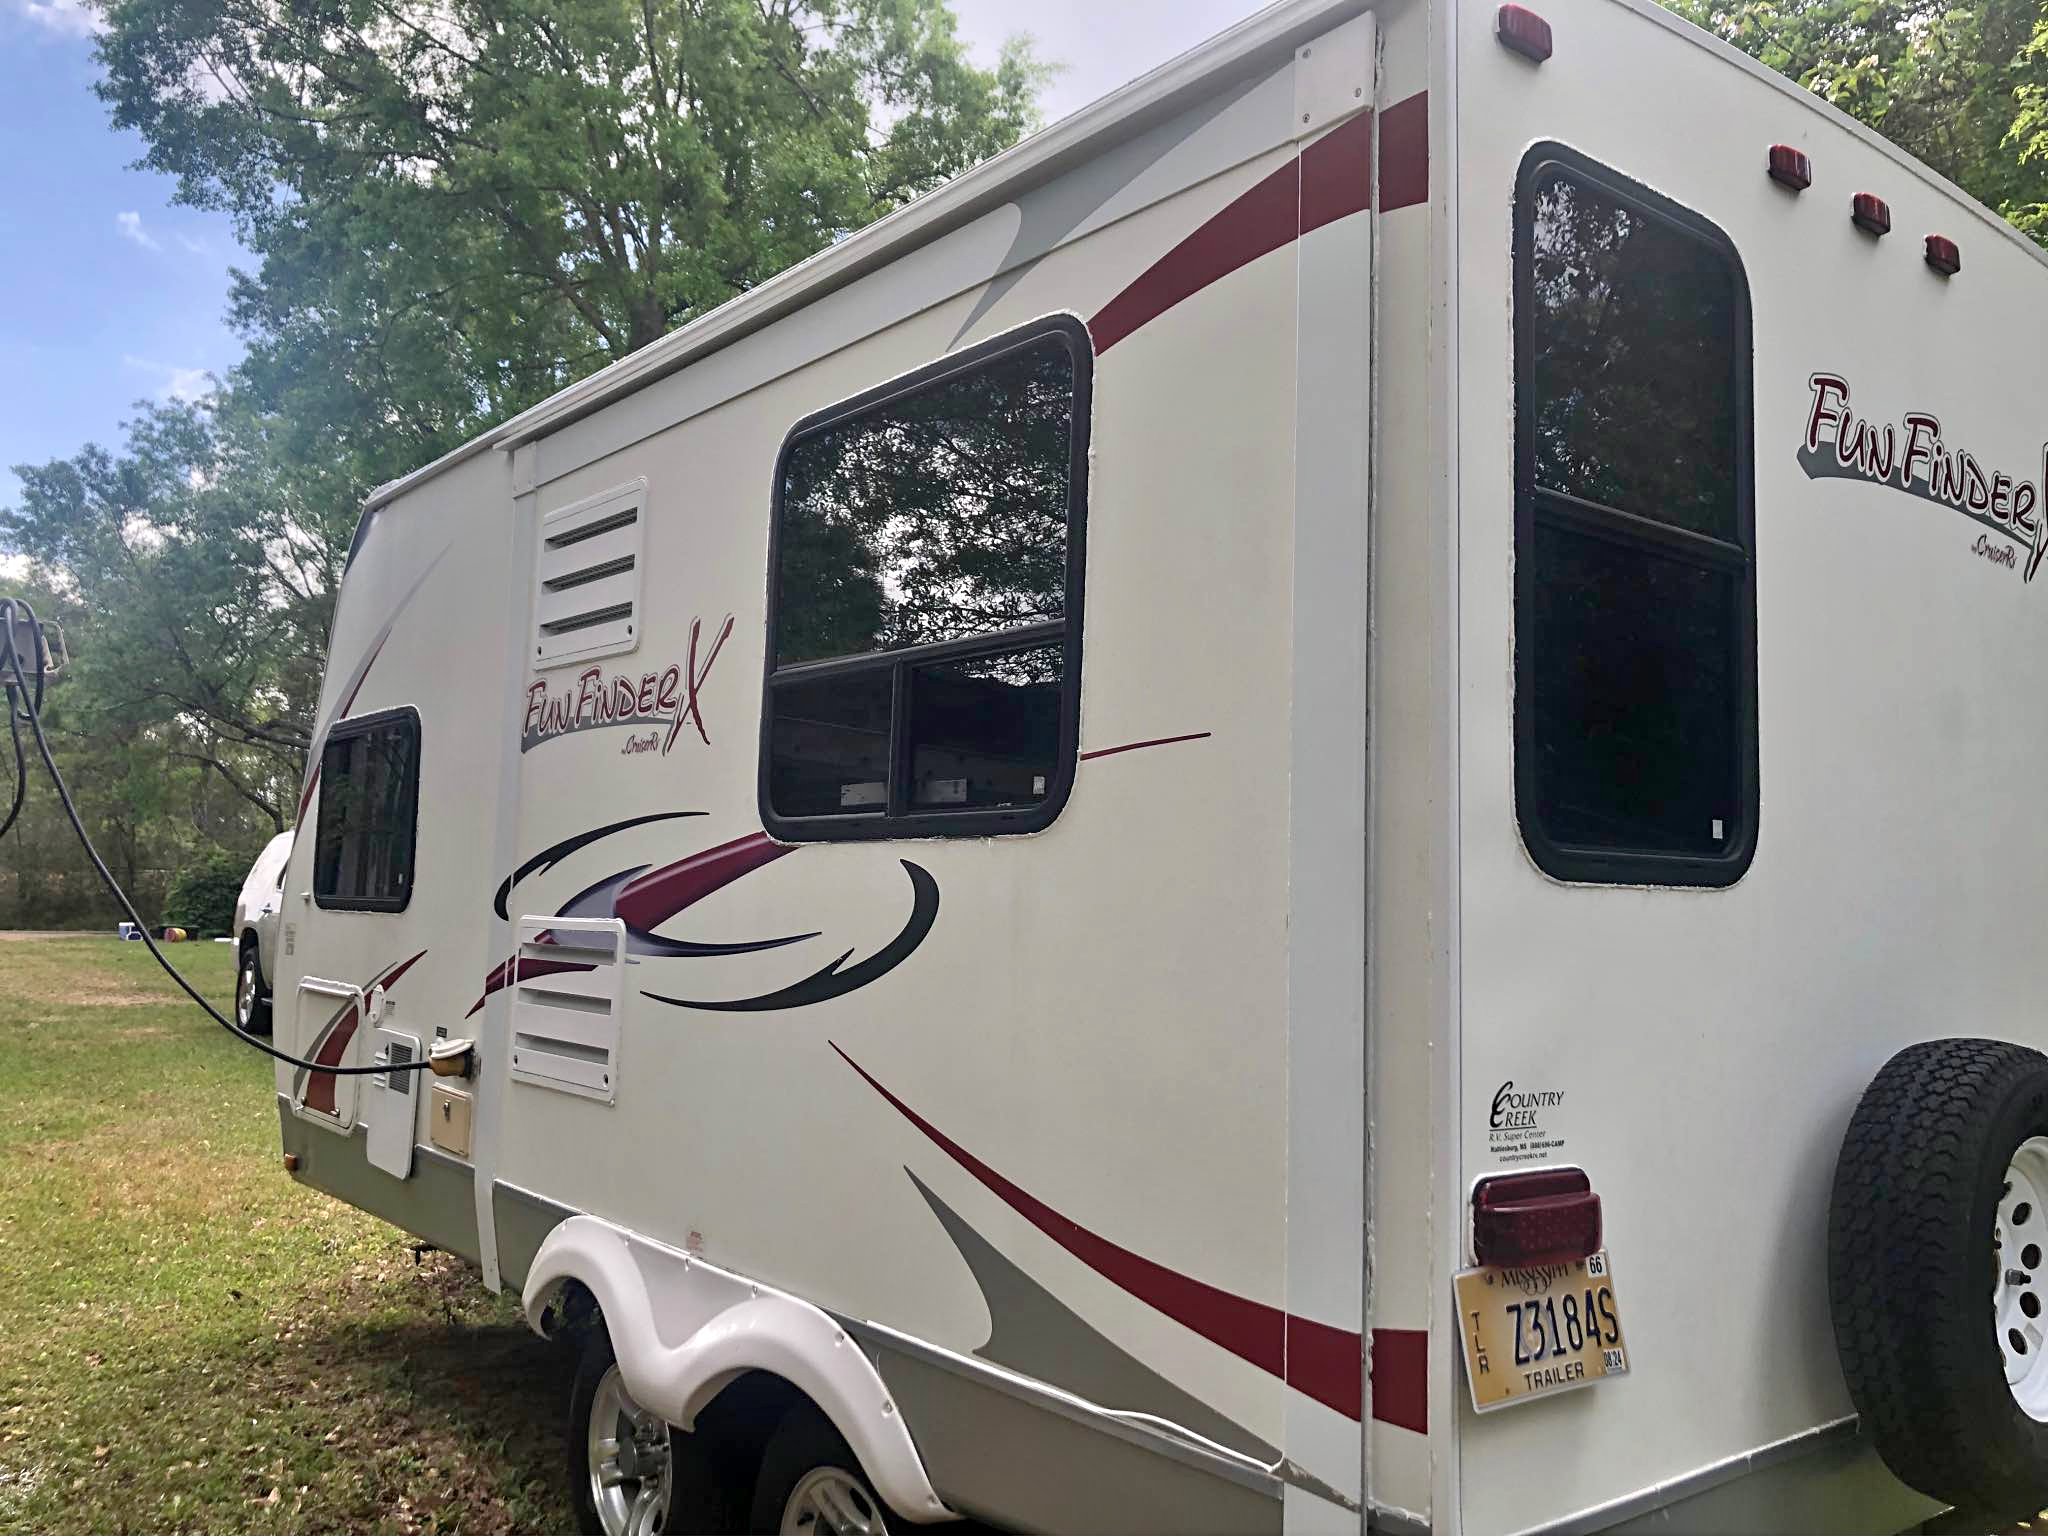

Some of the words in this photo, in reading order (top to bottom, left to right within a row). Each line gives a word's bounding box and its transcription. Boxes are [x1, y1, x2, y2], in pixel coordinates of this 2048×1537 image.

[1491, 1081, 1564, 1115] COUNTRY
[1503, 1131, 1522, 1142] Super
[1523, 1130, 1546, 1139] Center
[1590, 1256, 1603, 1274] 66
[1506, 1287, 1619, 1366] Z3184S
[1524, 1361, 1585, 1392] TRAILER
